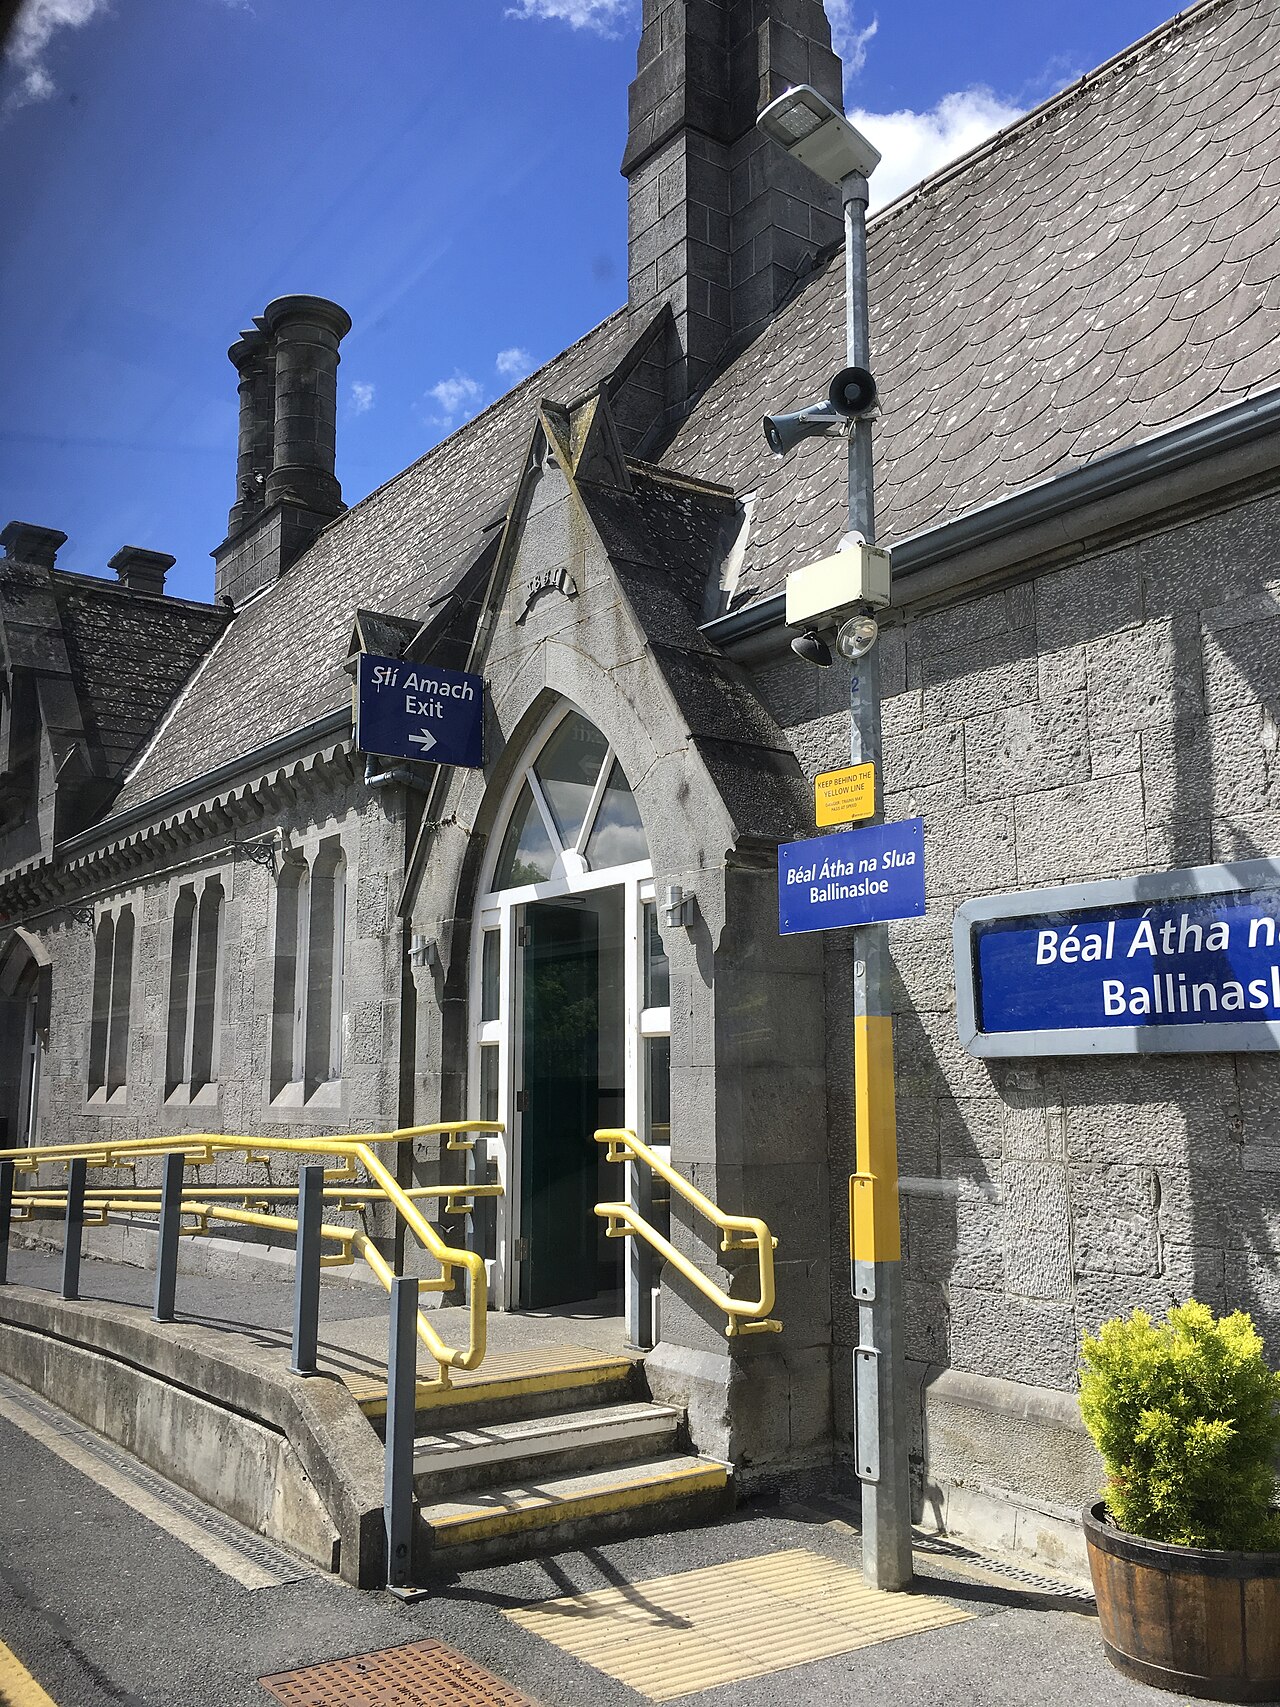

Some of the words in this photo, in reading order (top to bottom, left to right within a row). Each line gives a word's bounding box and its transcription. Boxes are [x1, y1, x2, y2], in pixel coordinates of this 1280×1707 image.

[371, 665, 399, 687] Slí
[402, 672, 474, 701] Amach
[851, 677, 860, 693] 2
[405, 694, 444, 719] Exit
[817, 779, 833, 790] KEEP
[834, 774, 858, 786] BEHIND
[859, 770, 872, 781] THE
[823, 786, 850, 798] YELLOW
[850, 782, 865, 793] LINE
[786, 863, 817, 885] Béal
[818, 857, 854, 880] Átha
[858, 857, 877, 873] na
[881, 849, 916, 870] Slua
[809, 877, 889, 903] Ballinasloe
[1036, 920, 1116, 965] Béal
[1126, 907, 1230, 958] Átha
[1247, 915, 1280, 948] n
